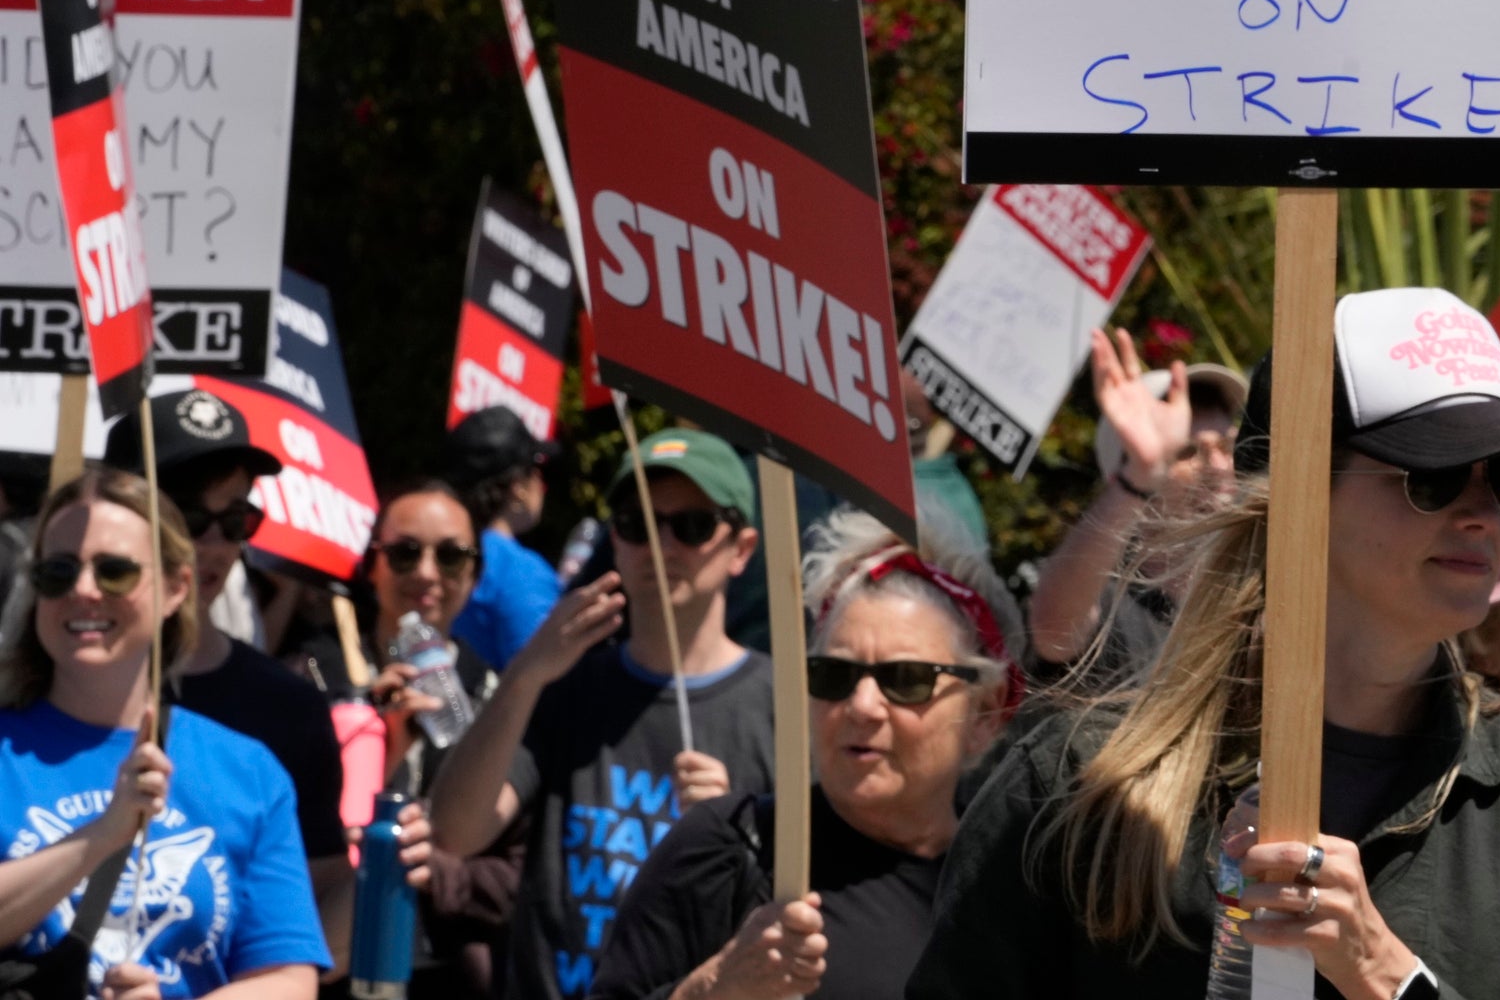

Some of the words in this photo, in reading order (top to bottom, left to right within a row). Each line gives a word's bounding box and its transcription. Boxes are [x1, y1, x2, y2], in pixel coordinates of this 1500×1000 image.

[138, 114, 225, 179] MY
[708, 146, 781, 240] ON
[591, 188, 898, 445] STRIKE!
